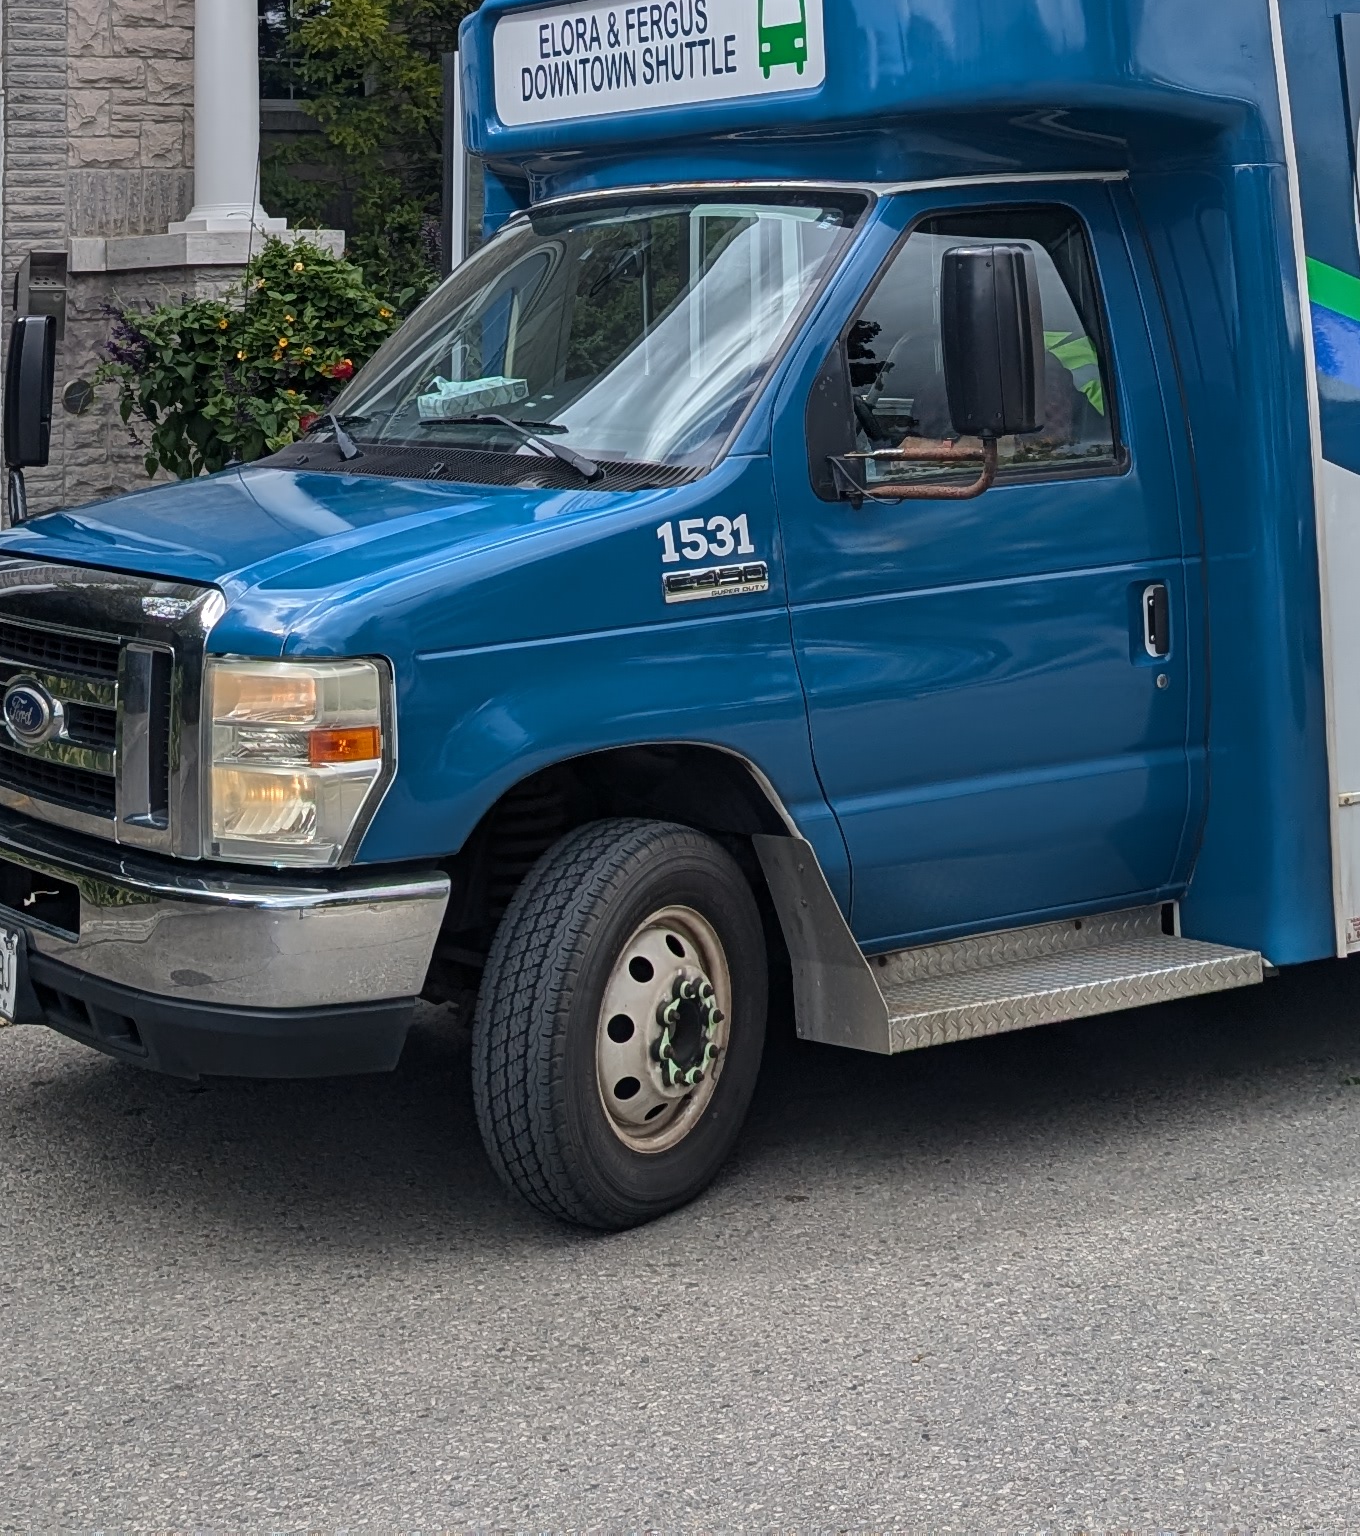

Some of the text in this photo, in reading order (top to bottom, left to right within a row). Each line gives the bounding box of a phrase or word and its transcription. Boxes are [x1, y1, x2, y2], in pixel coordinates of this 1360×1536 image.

[539, 15, 602, 60] ELORA
[606, 9, 621, 48] &
[521, 33, 737, 102] DOWNTOWN SHUTTLE
[656, 513, 755, 563] 1531
[711, 583, 766, 597] SUPER DUTY
[10, 695, 34, 725] Ford
